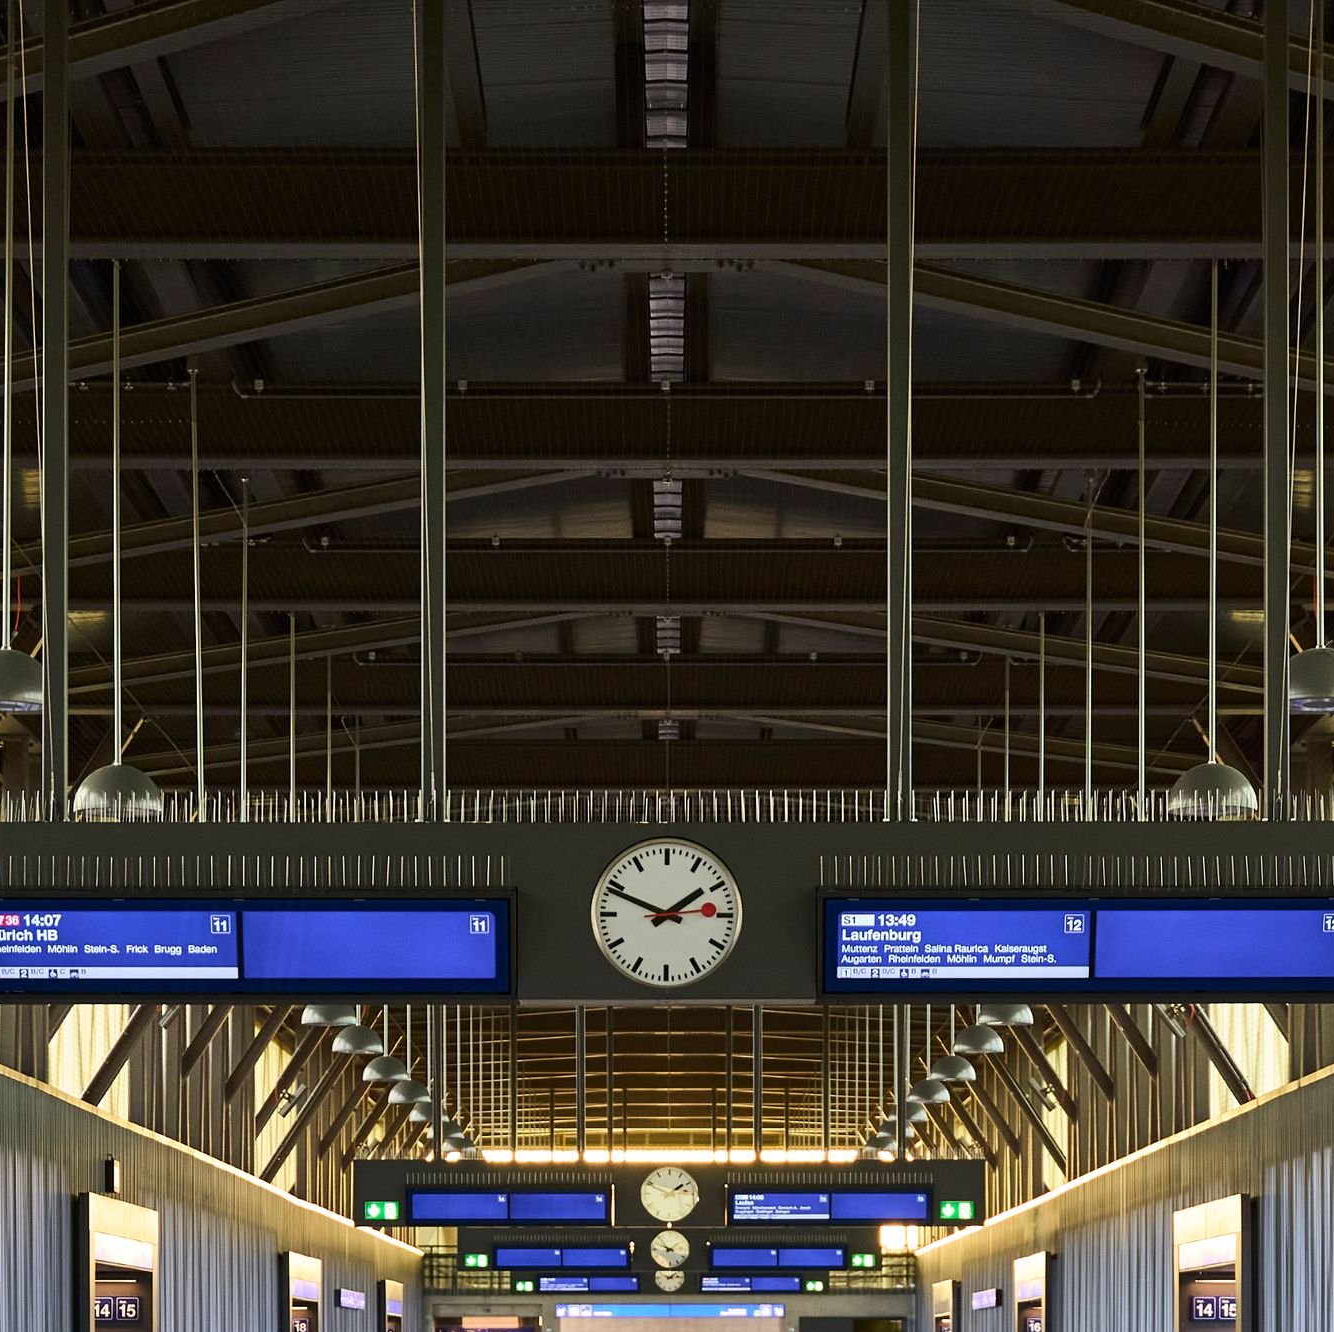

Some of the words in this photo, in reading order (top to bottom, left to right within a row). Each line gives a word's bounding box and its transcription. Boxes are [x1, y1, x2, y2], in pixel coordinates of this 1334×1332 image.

[5, 915, 19, 926] 36
[23, 914, 61, 927] 14:07
[213, 919, 227, 932] 11
[472, 919, 488, 932] 11
[843, 915, 857, 925] S1
[877, 914, 916, 927] 13:49
[1066, 919, 1083, 932] 12
[37, 930, 59, 942] HB
[841, 929, 922, 943] Laufenburg
[47, 944, 78, 954] Möhlin
[83, 944, 120, 954] Stein-S.
[126, 944, 148, 954] Frick
[154, 944, 182, 956] Brugg
[188, 944, 218, 954] Baden
[841, 944, 878, 953] Muttenz
[884, 944, 919, 953] Pratteln
[924, 944, 953, 953] Salina
[954, 944, 989, 953] Raurica
[994, 944, 1047, 955] Kaiseraugst
[841, 954, 882, 965] Augarten
[888, 954, 941, 963] Rheinfelden
[947, 954, 977, 964] Möhlin
[983, 954, 1015, 965] Mumpf
[1021, 954, 1057, 964] Stein-S.
[94, 1303, 111, 1318] 14
[119, 1303, 136, 1318] 15
[1196, 1303, 1214, 1317] 14
[1221, 1302, 1236, 1317] 15
[294, 1322, 307, 1332] 18
[1028, 1322, 1041, 1332] 16
